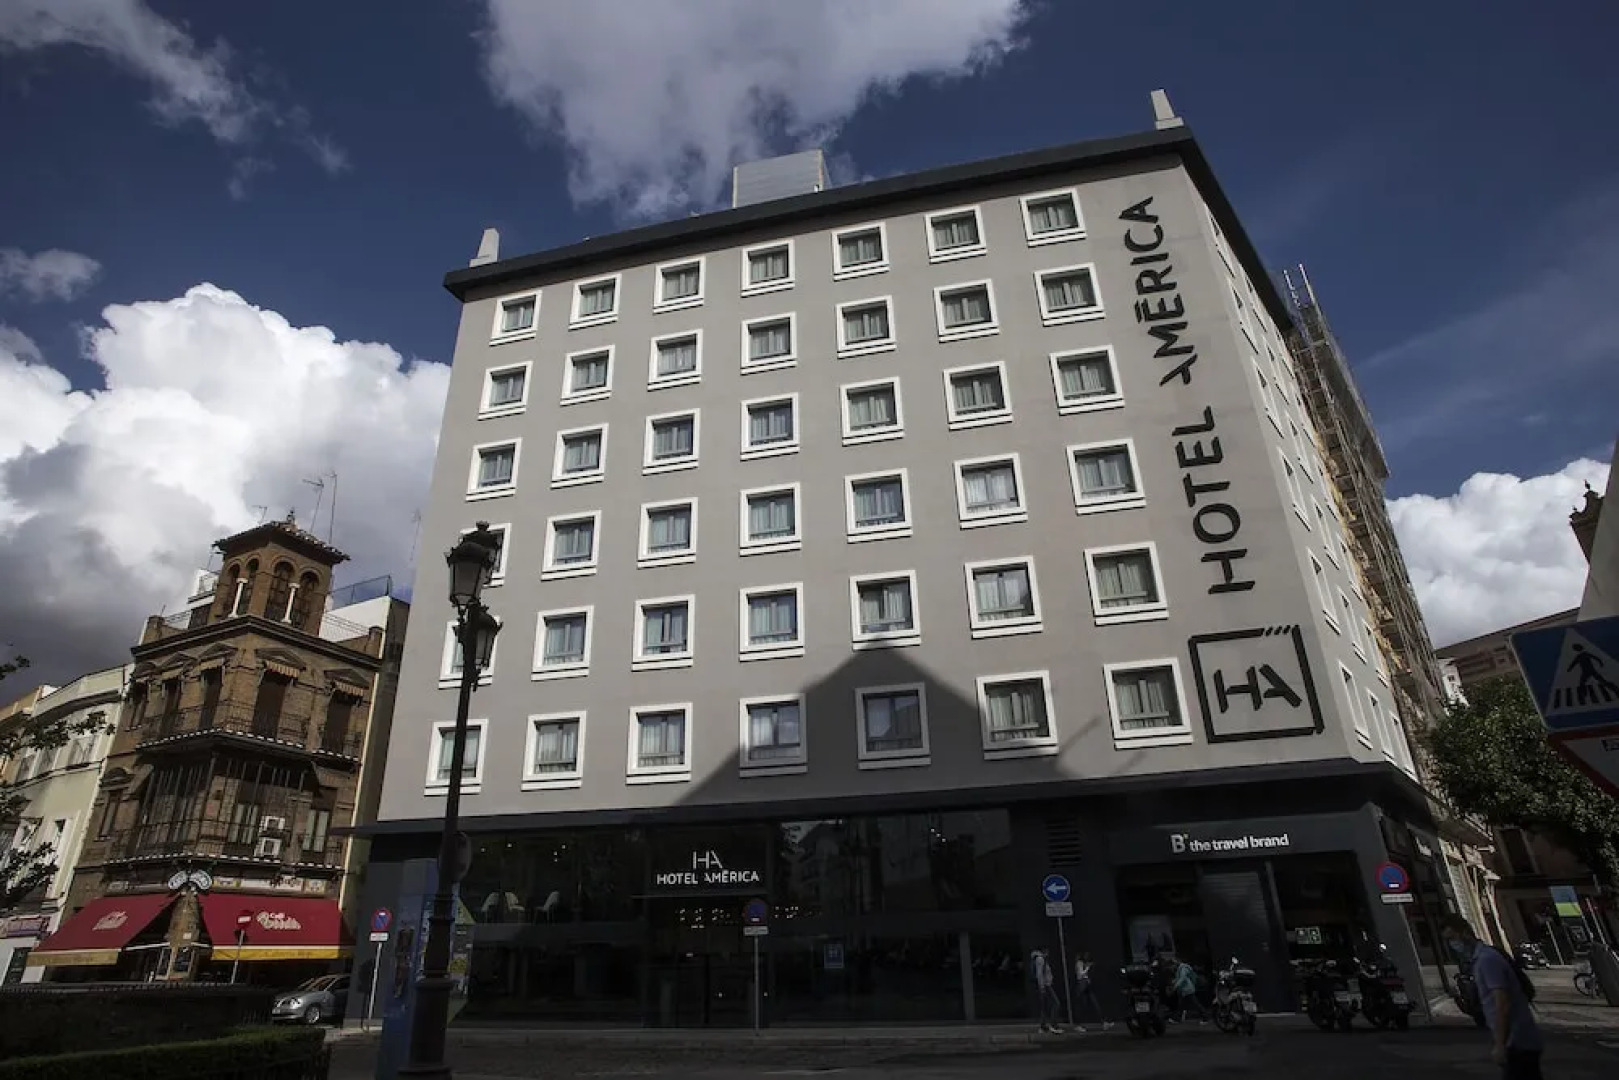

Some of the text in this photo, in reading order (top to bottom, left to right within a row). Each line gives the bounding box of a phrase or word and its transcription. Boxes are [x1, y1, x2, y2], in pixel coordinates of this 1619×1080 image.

[1172, 405, 1256, 594] HOTEL
[1213, 668, 1302, 714] HA
[1189, 839, 1212, 852] the
[1212, 836, 1249, 851] travel
[1249, 833, 1290, 848] brand
[692, 850, 723, 869] HA
[656, 872, 699, 885] HOTEL
